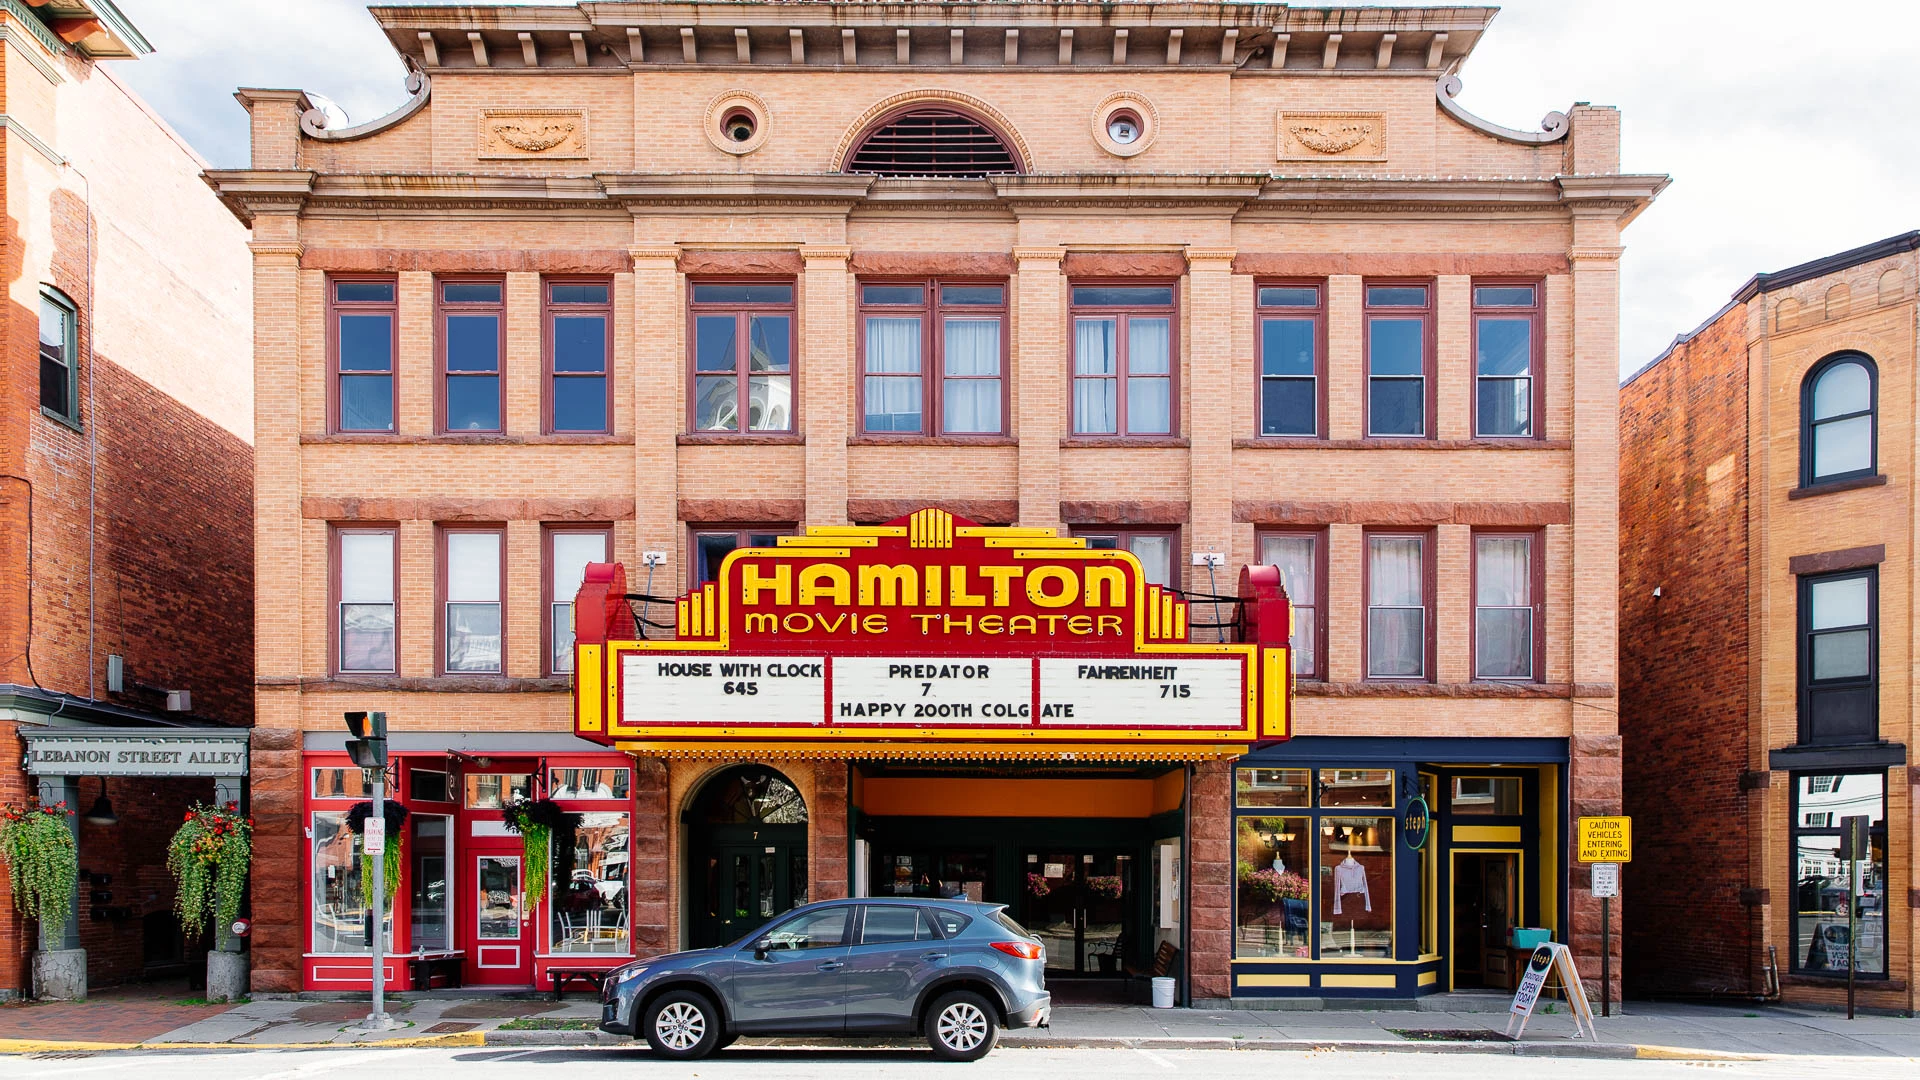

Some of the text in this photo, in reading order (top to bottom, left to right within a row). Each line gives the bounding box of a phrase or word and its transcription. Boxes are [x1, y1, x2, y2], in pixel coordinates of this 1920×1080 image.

[741, 563, 1128, 608] HAMILTON
[745, 612, 1124, 637] MOVIE THEATER
[658, 663, 822, 678] HOUSE WITH CLOCK
[889, 664, 990, 679] PREDATOR
[1078, 666, 1178, 680] FAHRENHEIT
[724, 681, 758, 696] 645
[921, 682, 932, 697] 7
[1159, 684, 1191, 699] 715
[840, 703, 1074, 718] HAPPY 200TH COLG ATE
[32, 750, 243, 765] LEBANON STREET ALLEY
[1405, 811, 1426, 835] steph
[753, 831, 759, 840] 7
[1521, 982, 1537, 994] OPEN
[1516, 991, 1535, 1005] TODAY
